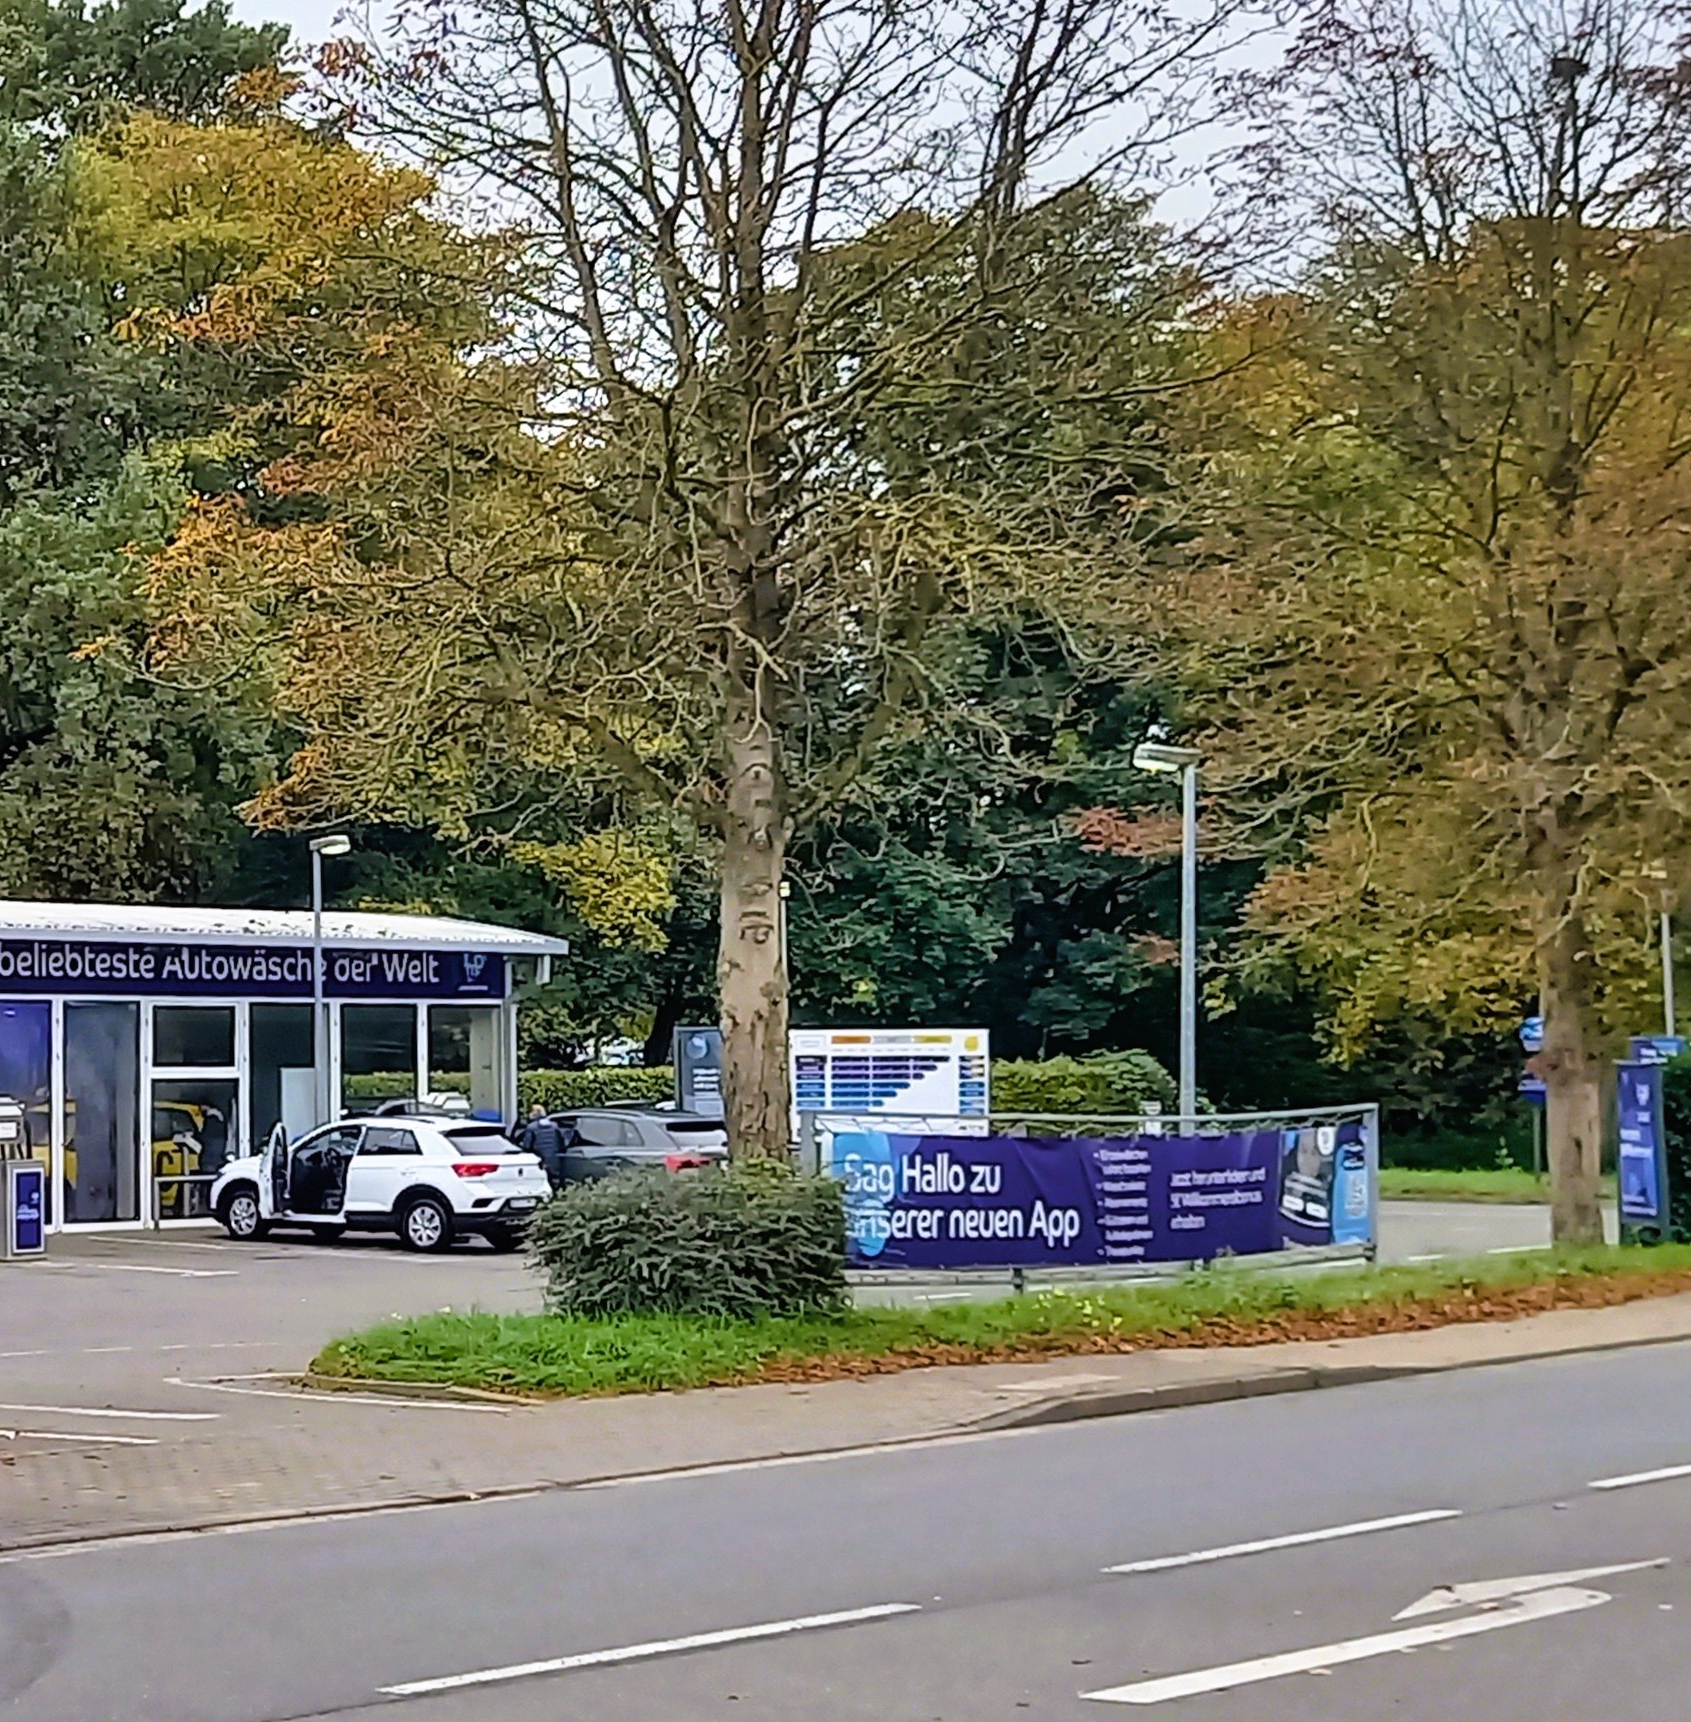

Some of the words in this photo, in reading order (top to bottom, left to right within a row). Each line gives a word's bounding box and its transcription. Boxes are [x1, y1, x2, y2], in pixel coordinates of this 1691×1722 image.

[334, 956, 377, 982] der
[381, 952, 440, 983] Welt
[845, 1153, 895, 1204] Sag
[902, 1152, 966, 1194] Hallo
[970, 1165, 1002, 1195] zu
[949, 1208, 1024, 1239] neuen
[1028, 1199, 1081, 1248] App
